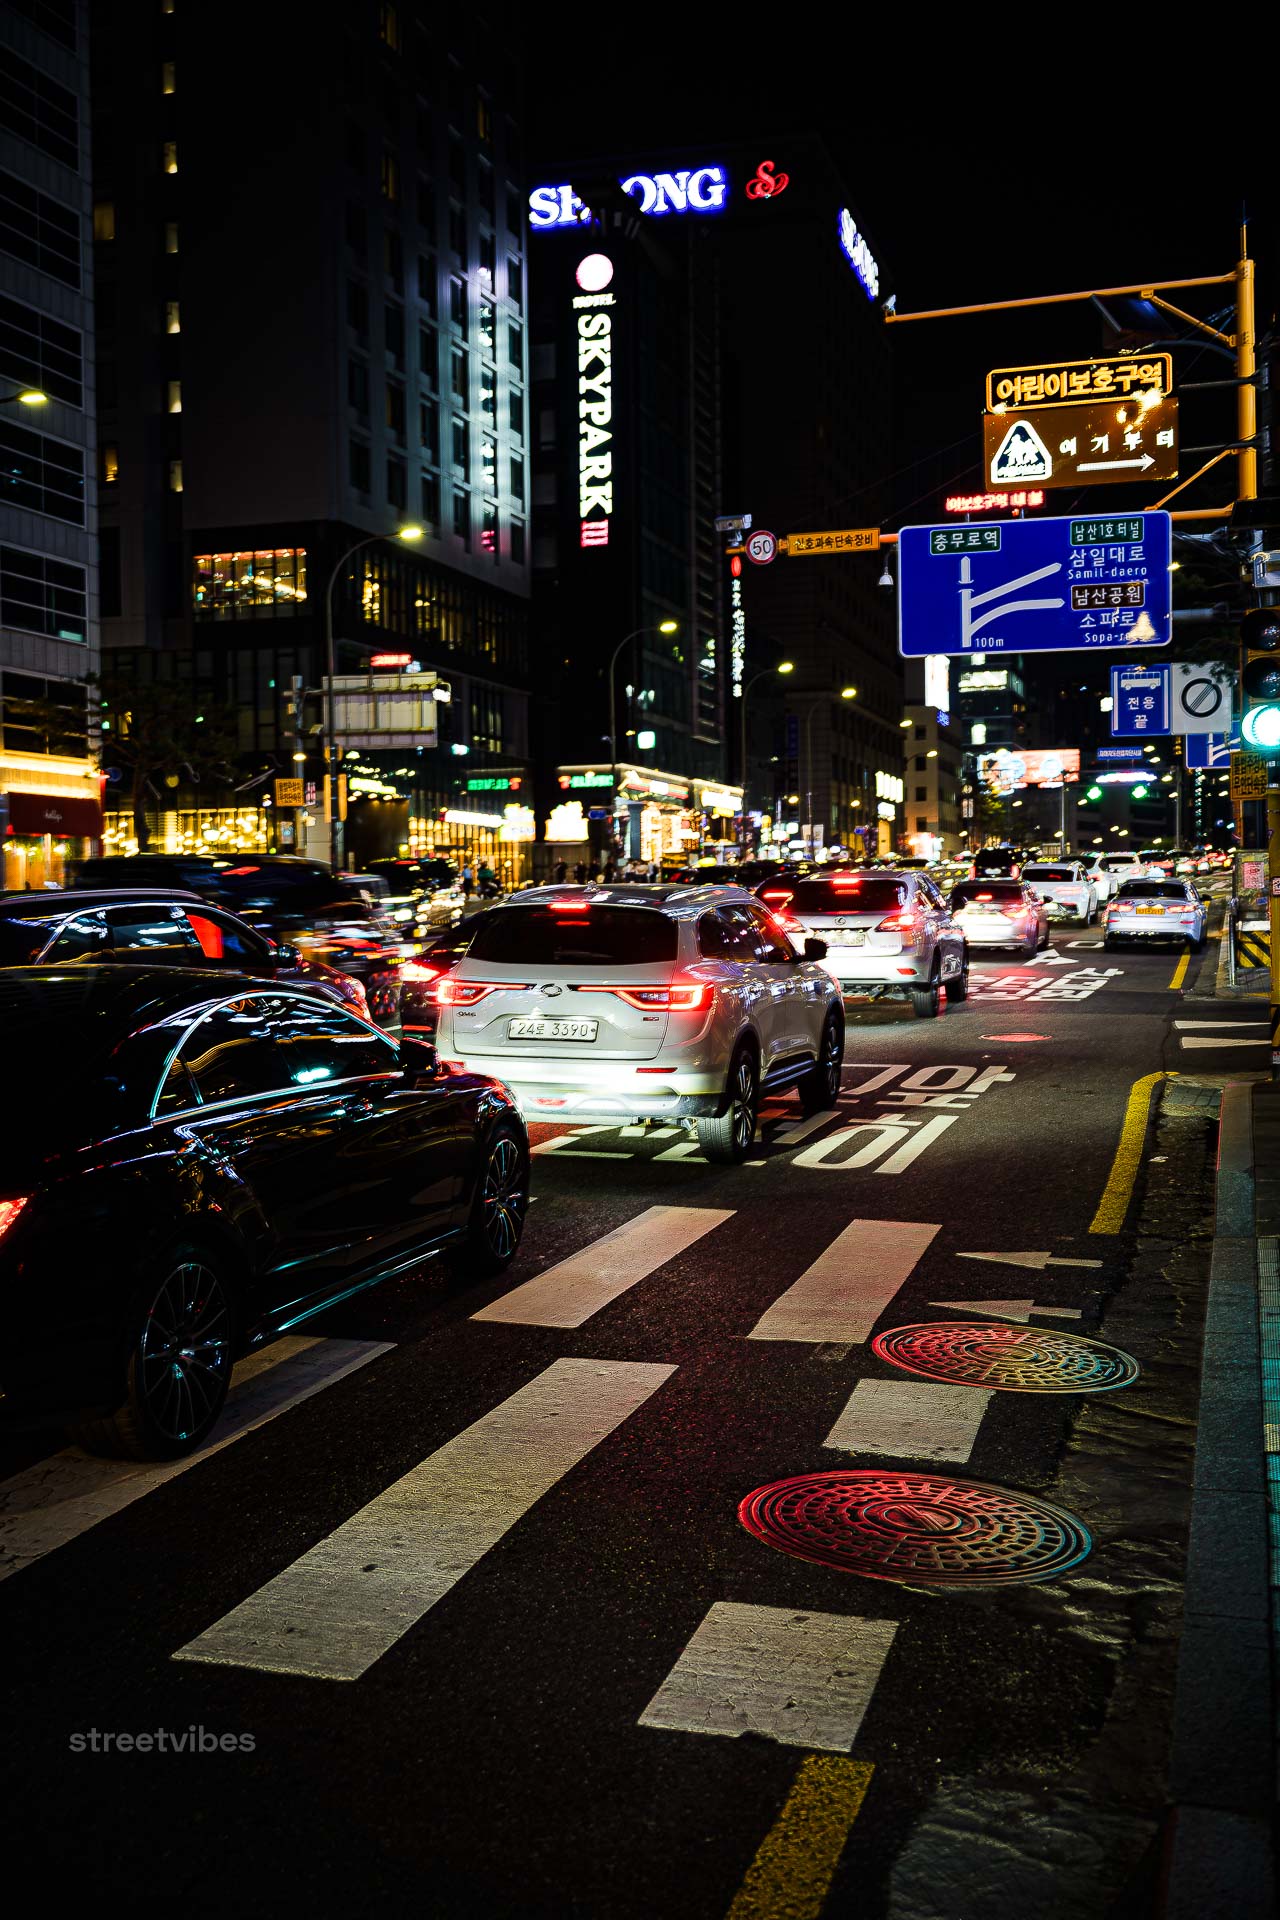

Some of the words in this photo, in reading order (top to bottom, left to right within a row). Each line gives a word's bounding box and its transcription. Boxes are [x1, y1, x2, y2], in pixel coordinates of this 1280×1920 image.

[528, 167, 726, 227] SEONG
[996, 362, 1163, 402] 어린이보호구역
[577, 313, 614, 518] SKYPARK
[1075, 521, 1139, 541] 남산1호터널
[753, 539, 771, 556] 50
[795, 533, 873, 551] 신호과속단속장비
[934, 530, 998, 551] 충무로역
[1069, 545, 1146, 568] 삼일대로
[1068, 567, 1147, 579] Samil-daero
[1075, 586, 1141, 606] 남산공원
[1080, 611, 1137, 628] 소파로
[975, 637, 1004, 648] 100m
[1127, 696, 1155, 711] 전용
[1134, 715, 1148, 729] 끝
[552, 1022, 589, 1036] 3390
